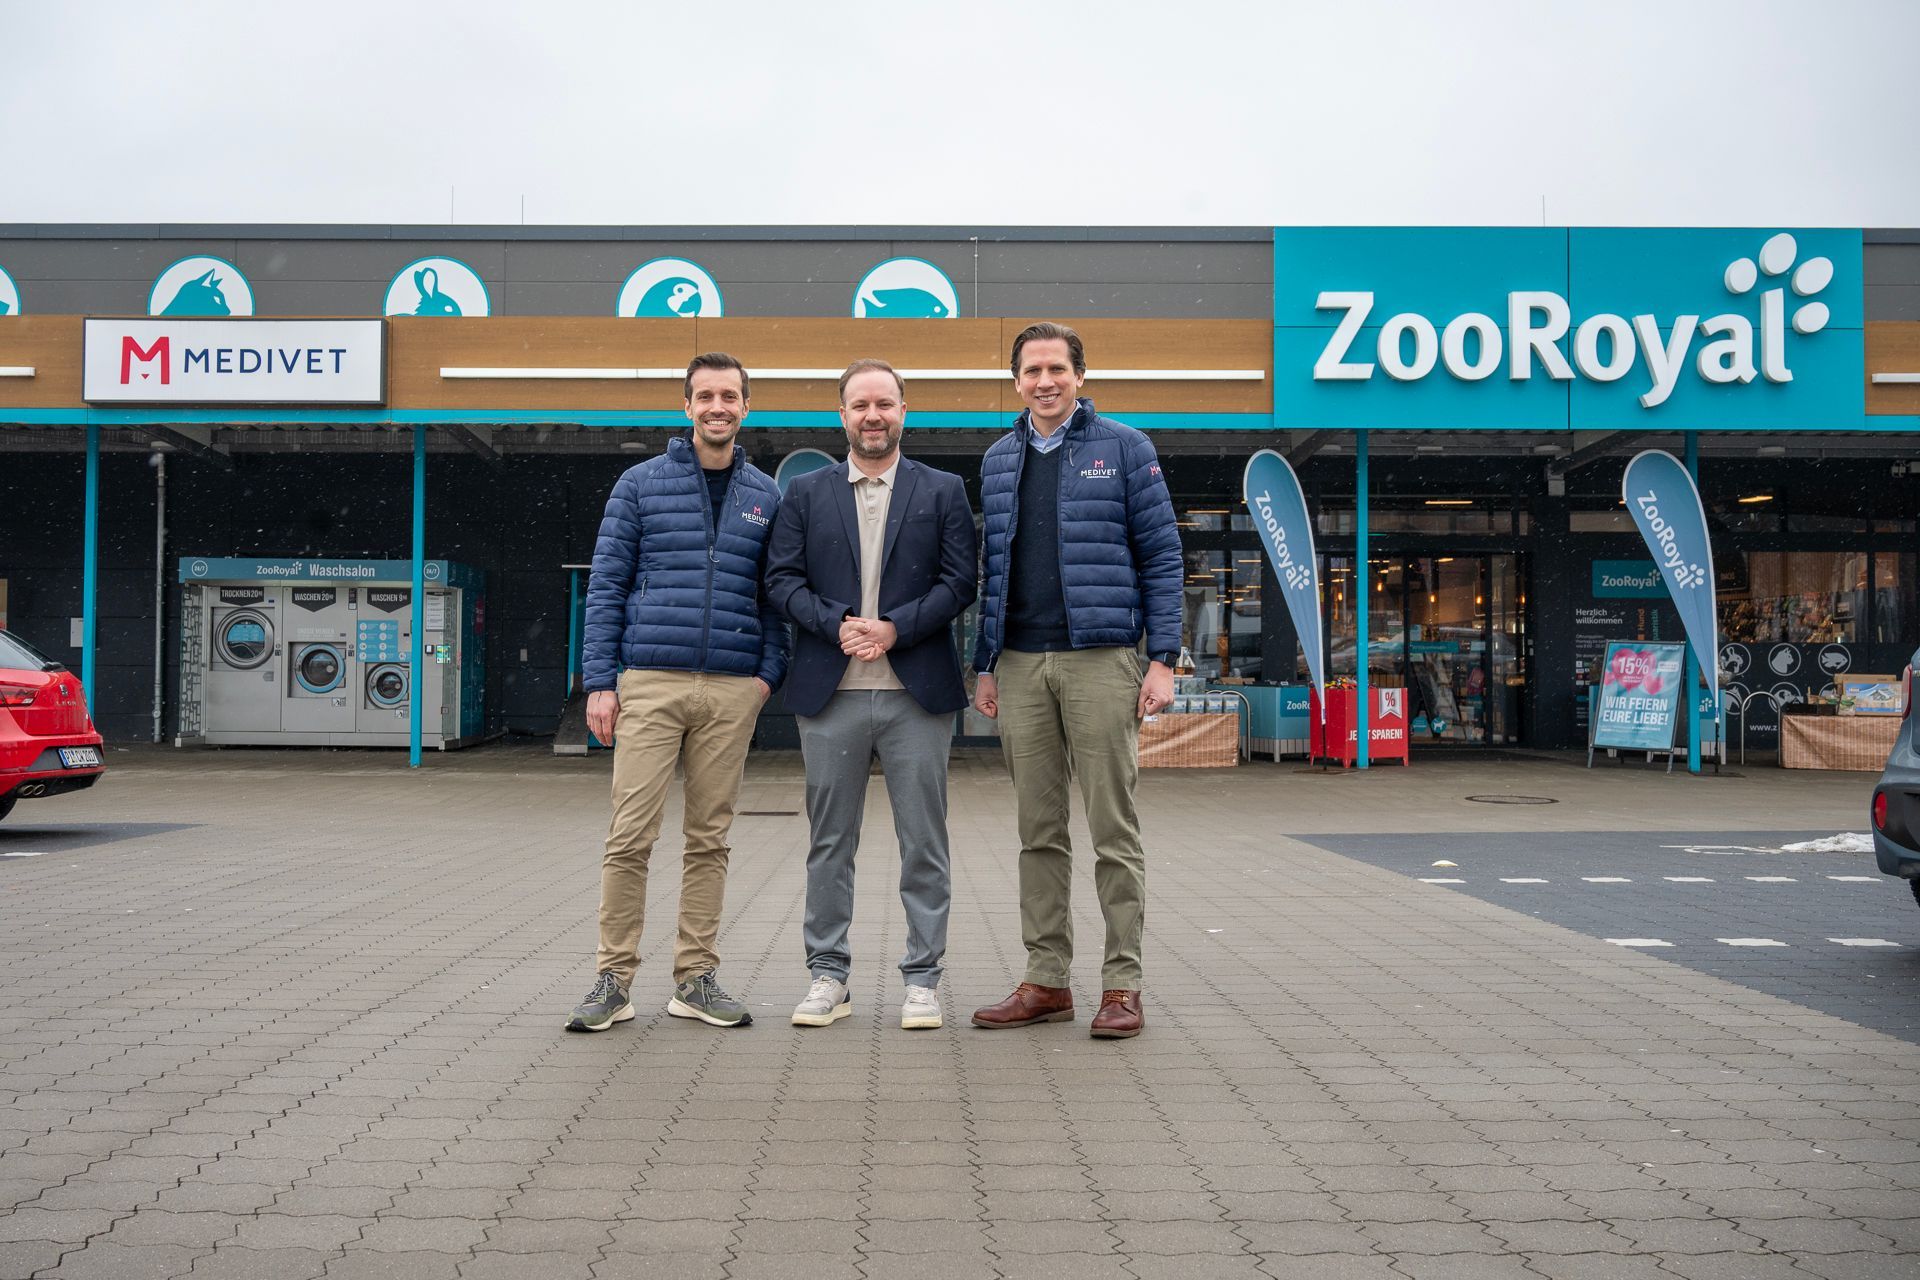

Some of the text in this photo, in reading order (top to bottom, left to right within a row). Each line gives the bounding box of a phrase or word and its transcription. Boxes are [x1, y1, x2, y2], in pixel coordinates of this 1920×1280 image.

[1313, 287, 1795, 409] ZooRoyal
[184, 348, 347, 374] MEDIVET
[1080, 468, 1117, 477] MEDIVET
[741, 512, 770, 525] MEDIVET
[1255, 489, 1304, 590] ZooRoyal
[1637, 489, 1696, 589] ZooRoyal
[256, 563, 376, 578] ZooRoyal Waschsalon
[1601, 574, 1657, 590] ZooRoyal
[221, 589, 250, 598] TROCKNEN
[294, 593, 321, 601] WASCHEN
[371, 594, 398, 602] WASCHEN
[1575, 608, 1608, 616] Herzlich
[1637, 608, 1645, 631] Hund
[1575, 616, 1623, 624] willkommen
[1618, 656, 1649, 675] 15%
[1605, 695, 1668, 711] WIR FEIERN
[1602, 709, 1632, 724] EURE
[1633, 711, 1669, 725] LIEBE!
[1371, 728, 1402, 740] SPAREN!
